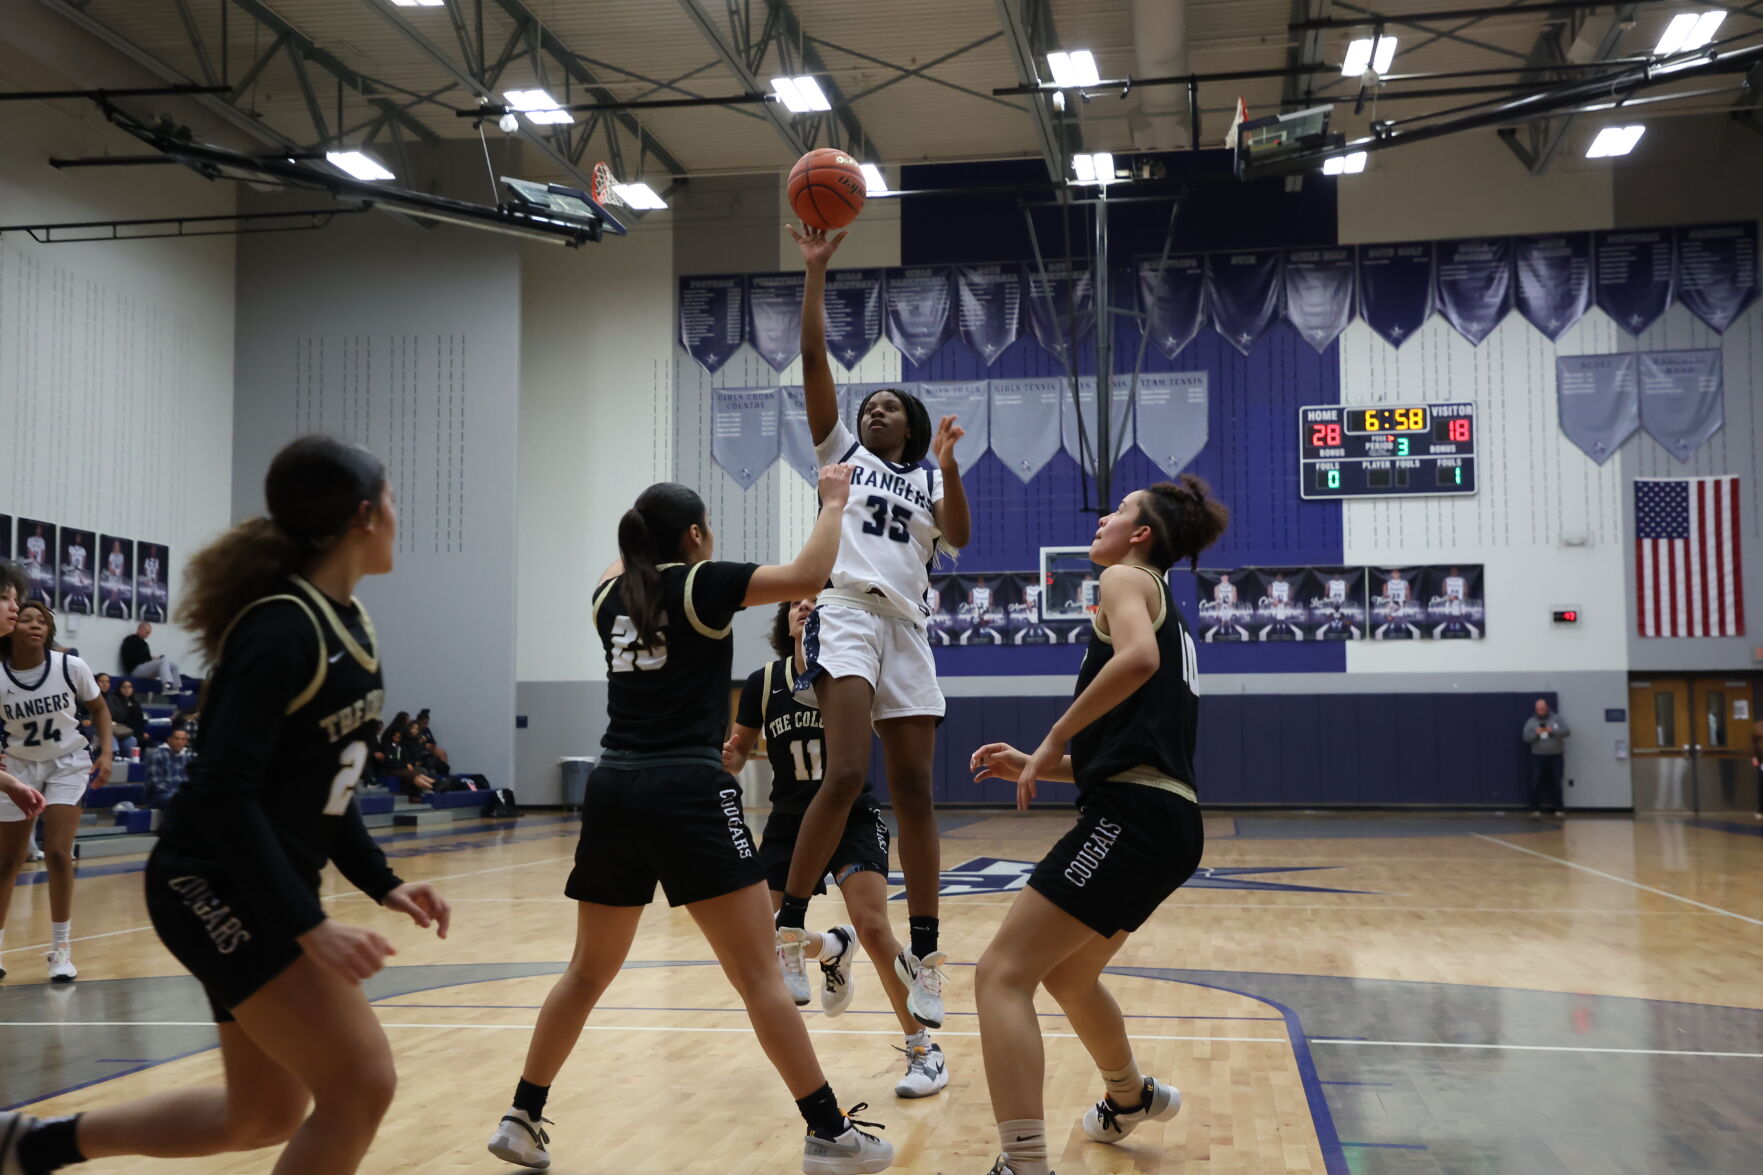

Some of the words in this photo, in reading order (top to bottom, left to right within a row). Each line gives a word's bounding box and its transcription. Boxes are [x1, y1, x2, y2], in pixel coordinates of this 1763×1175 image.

[1024, 383, 1056, 392] TENNIS
[1170, 377, 1203, 385] TENNIS
[1308, 410, 1337, 421] HOME
[1365, 408, 1424, 431] 6:58
[1431, 405, 1473, 417] VISITOR
[1312, 424, 1341, 446] 28
[1448, 419, 1470, 441] 18
[1365, 442, 1393, 450] PERIOD
[1397, 437, 1409, 456] 3
[1316, 462, 1340, 470] FOULS
[1362, 461, 1390, 469] PLAYER
[1396, 460, 1420, 468] FOULS
[1328, 471, 1340, 488] 0
[862, 495, 913, 543] 35
[3, 692, 70, 720] RANGERS
[23, 718, 62, 747] 24
[769, 714, 792, 738] THE
[790, 739, 823, 780] 11
[322, 741, 369, 815] 2
